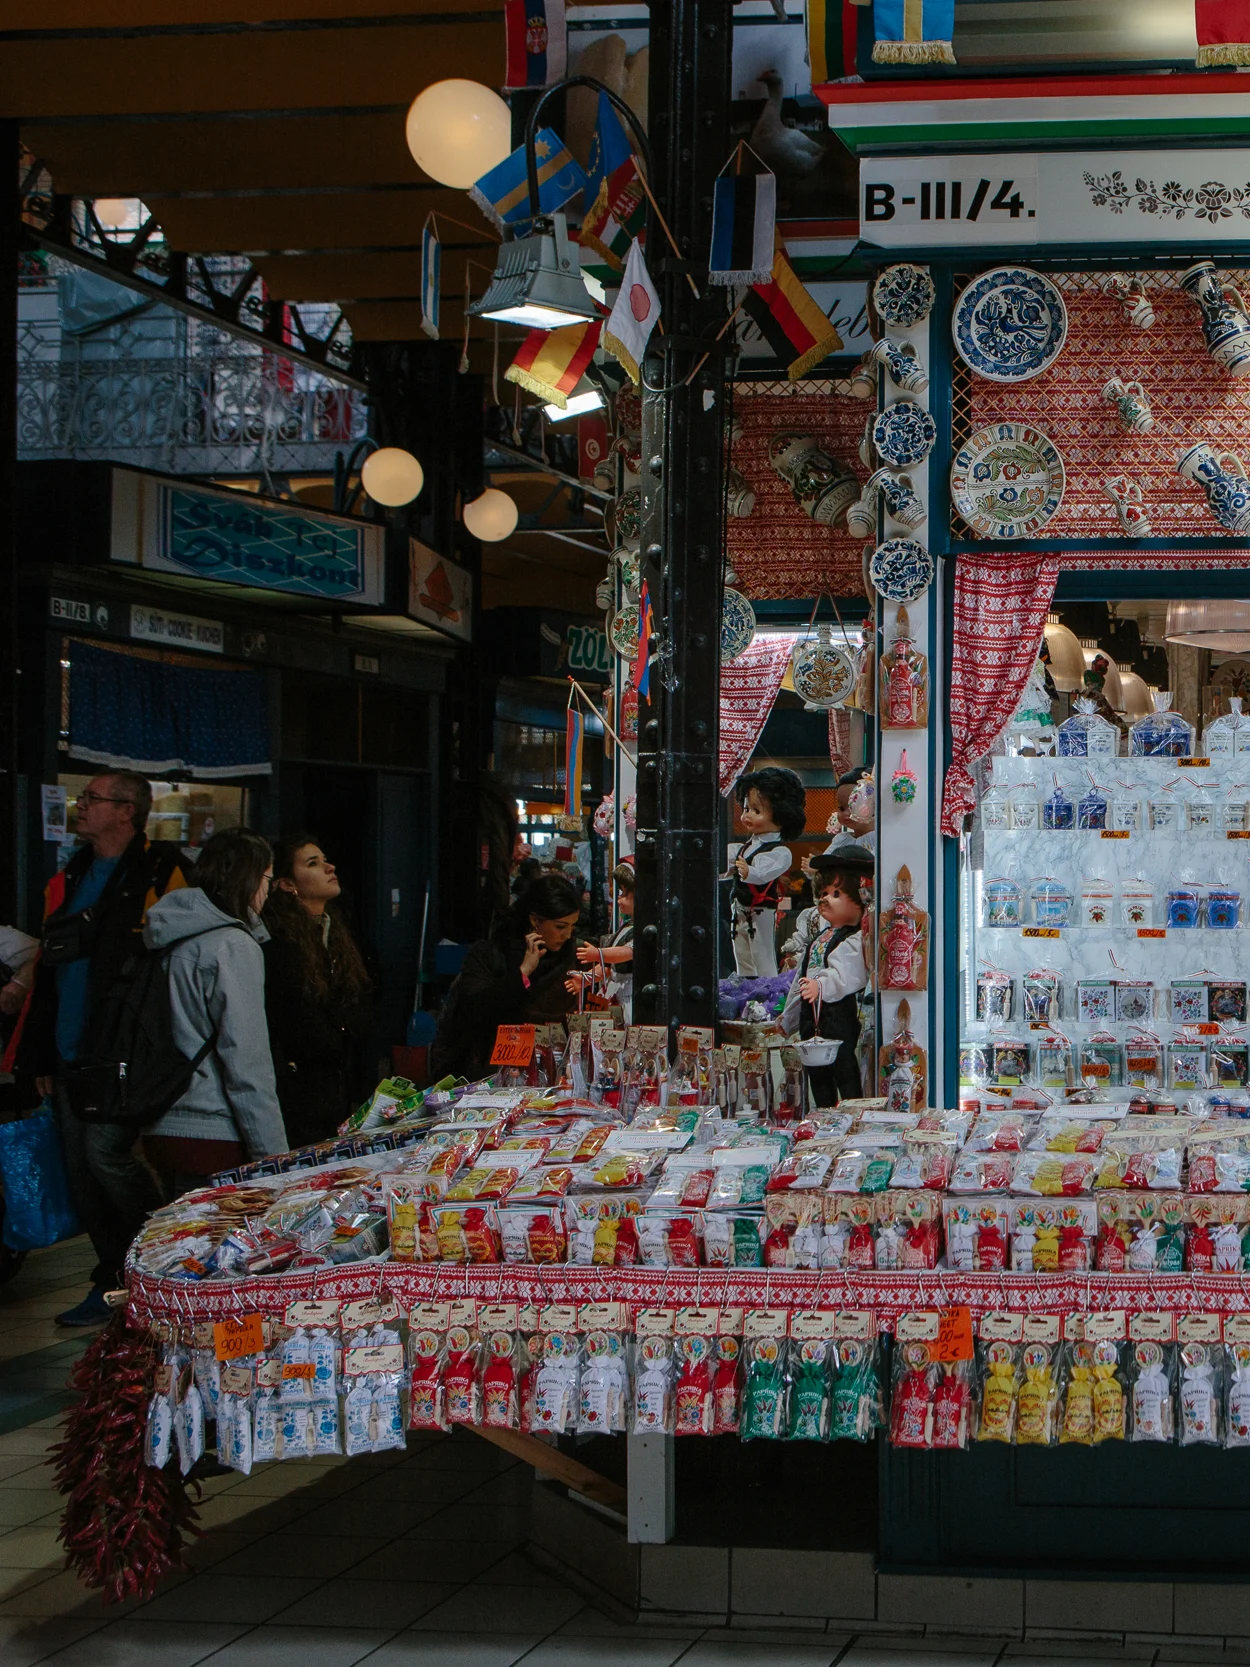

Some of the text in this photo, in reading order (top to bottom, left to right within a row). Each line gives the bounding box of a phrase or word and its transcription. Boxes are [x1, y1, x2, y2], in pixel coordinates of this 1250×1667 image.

[864, 178, 1037, 222] B-III/4.
[567, 625, 615, 672] ZÖL
[939, 1344, 949, 1360] 2
[412, 1379, 437, 1389] PAPRIKA
[445, 1375, 469, 1385] PAPRIKA
[484, 1379, 509, 1389] PAPRIKA
[677, 1384, 702, 1395] PAPRIKA
[752, 1388, 778, 1399] PAPRIKA
[834, 1388, 859, 1397] PAPRIKA
[797, 1391, 823, 1399] PAPRIKA
